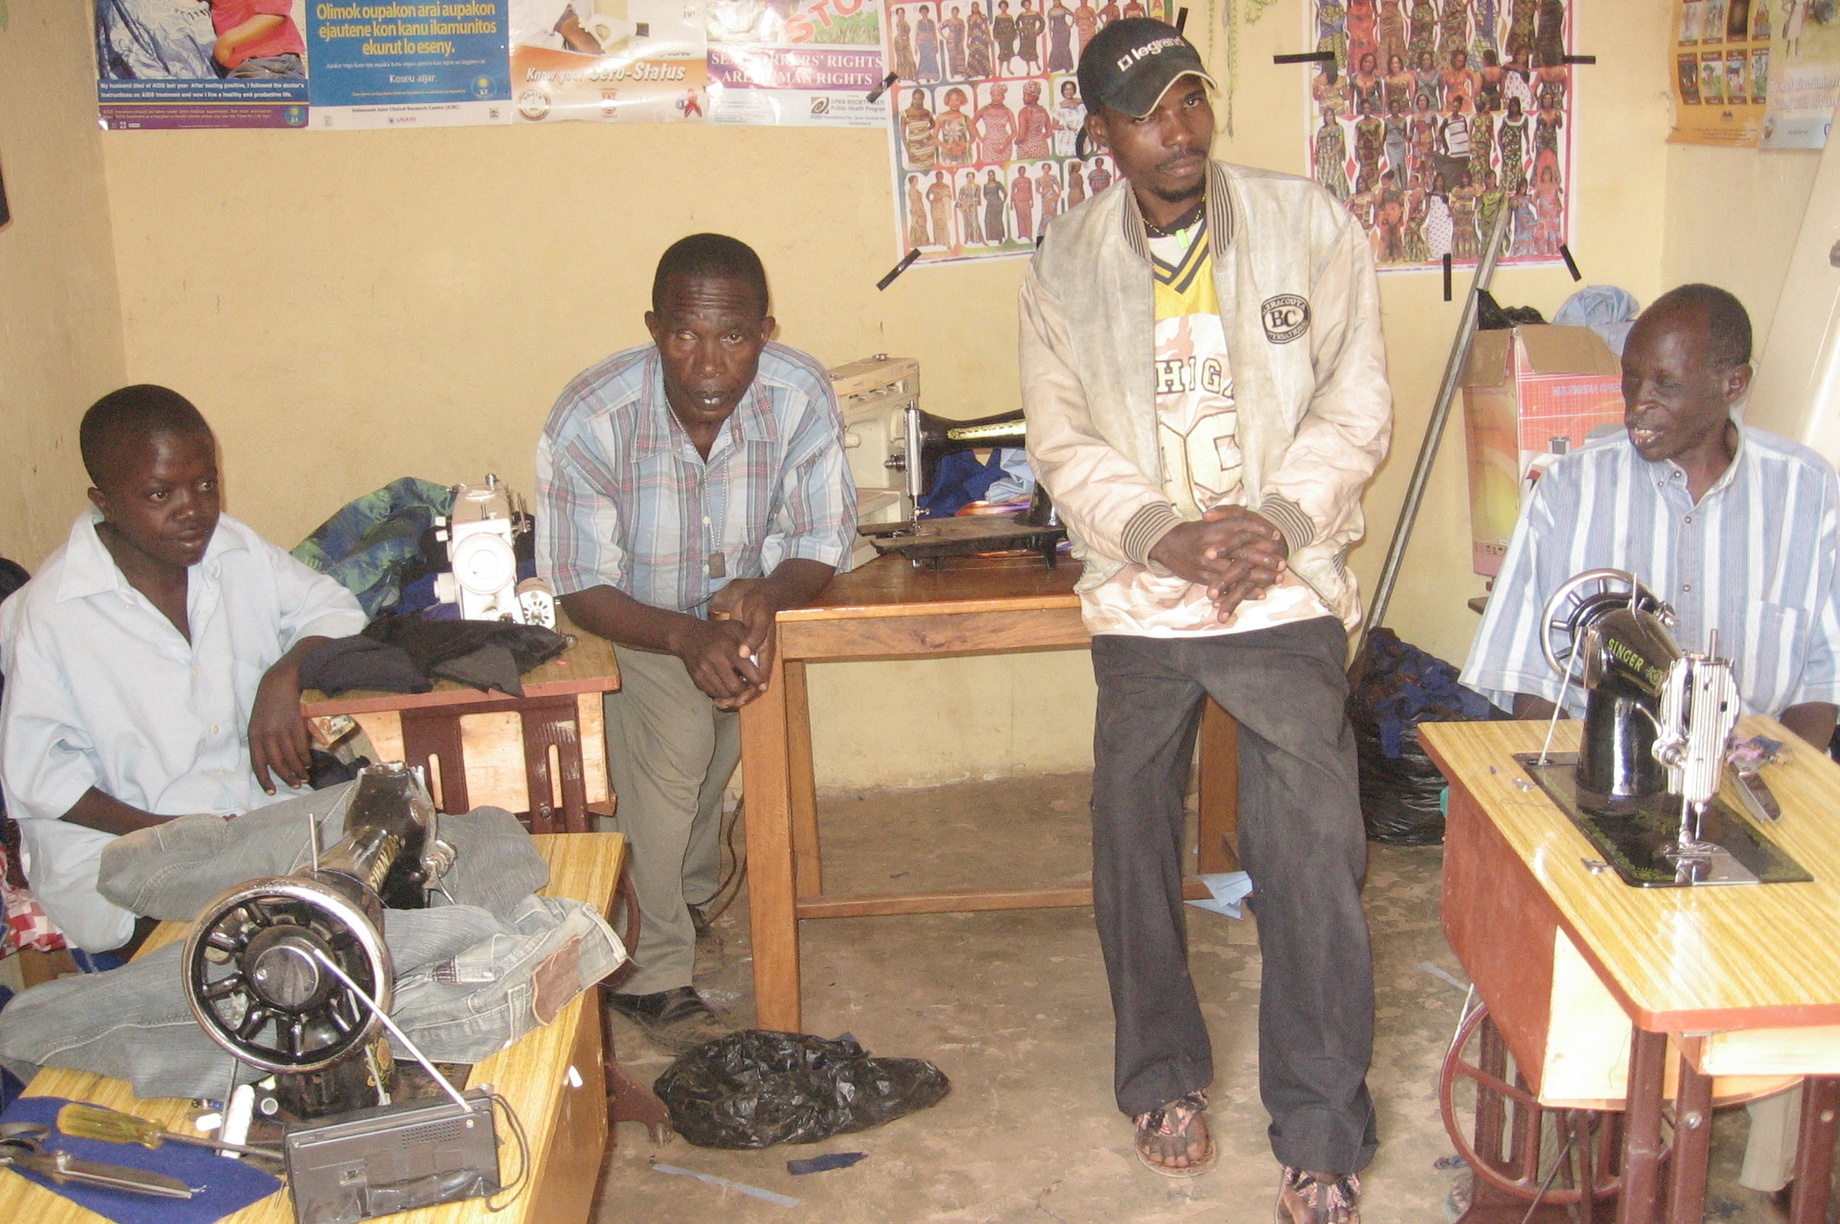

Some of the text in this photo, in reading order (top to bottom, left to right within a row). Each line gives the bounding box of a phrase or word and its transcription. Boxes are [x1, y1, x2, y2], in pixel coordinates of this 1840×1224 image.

[317, 0, 495, 22] Olimok oupakon arai aupakon
[319, 18, 497, 42] ejautene kon kanu ikamunitos
[785, 0, 874, 44] STO
[362, 38, 456, 57] ekurut lo eseny.
[827, 55, 883, 69] RIGHTS
[526, 67, 556, 82] Know
[816, 72, 873, 86] RIGHTS
[1269, 308, 1298, 328] BC
[1607, 638, 1645, 672] SINGER
